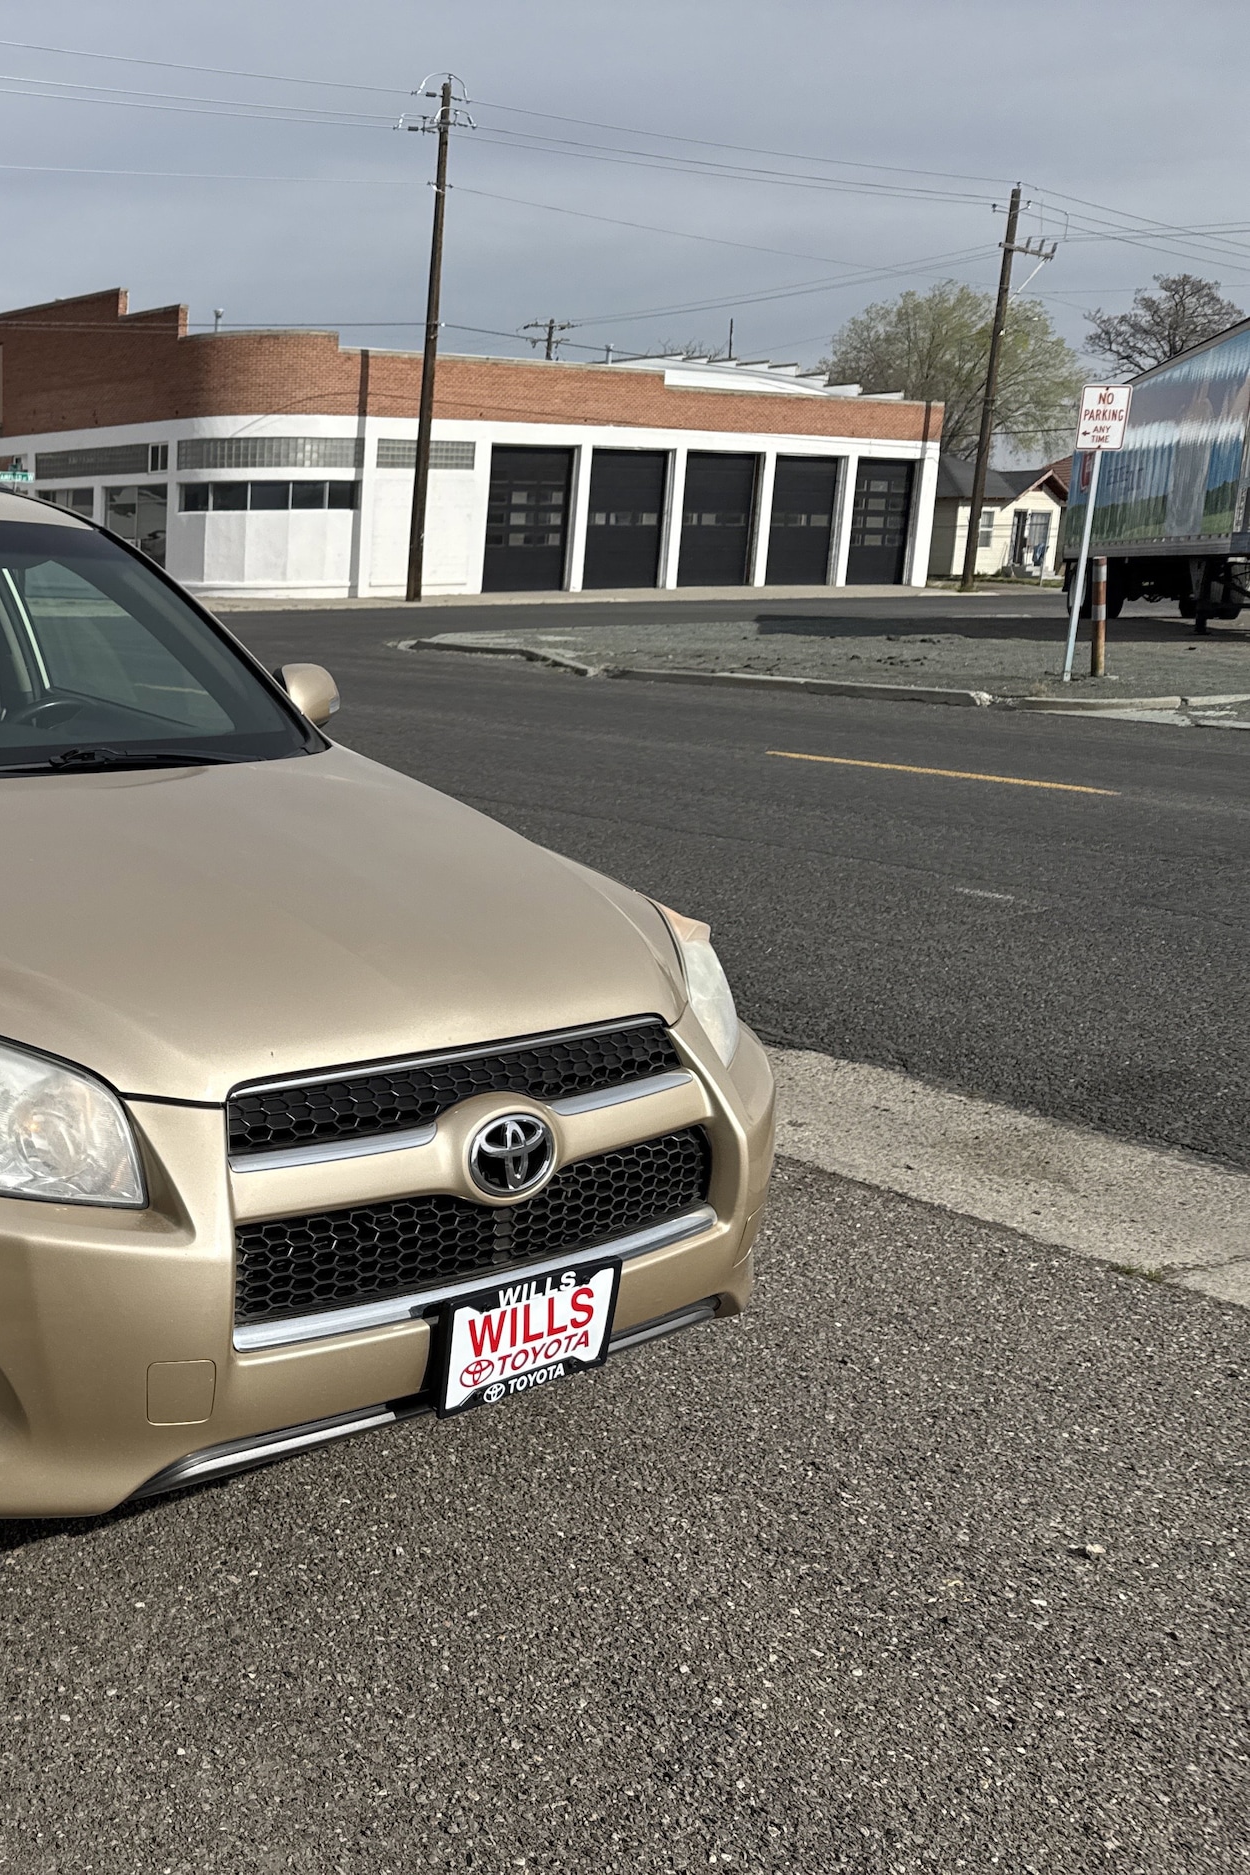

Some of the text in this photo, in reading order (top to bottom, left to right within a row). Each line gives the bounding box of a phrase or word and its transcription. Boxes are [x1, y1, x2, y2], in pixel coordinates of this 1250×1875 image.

[1097, 392, 1115, 405] NO
[1083, 409, 1124, 422] PARKING
[1091, 435, 1110, 443] TIME
[1093, 425, 1111, 433] ANY
[499, 1271, 577, 1309] WILLS
[468, 1287, 594, 1358] WILLS
[498, 1330, 590, 1376] TOYOTA
[508, 1363, 565, 1394] TOYOTA
